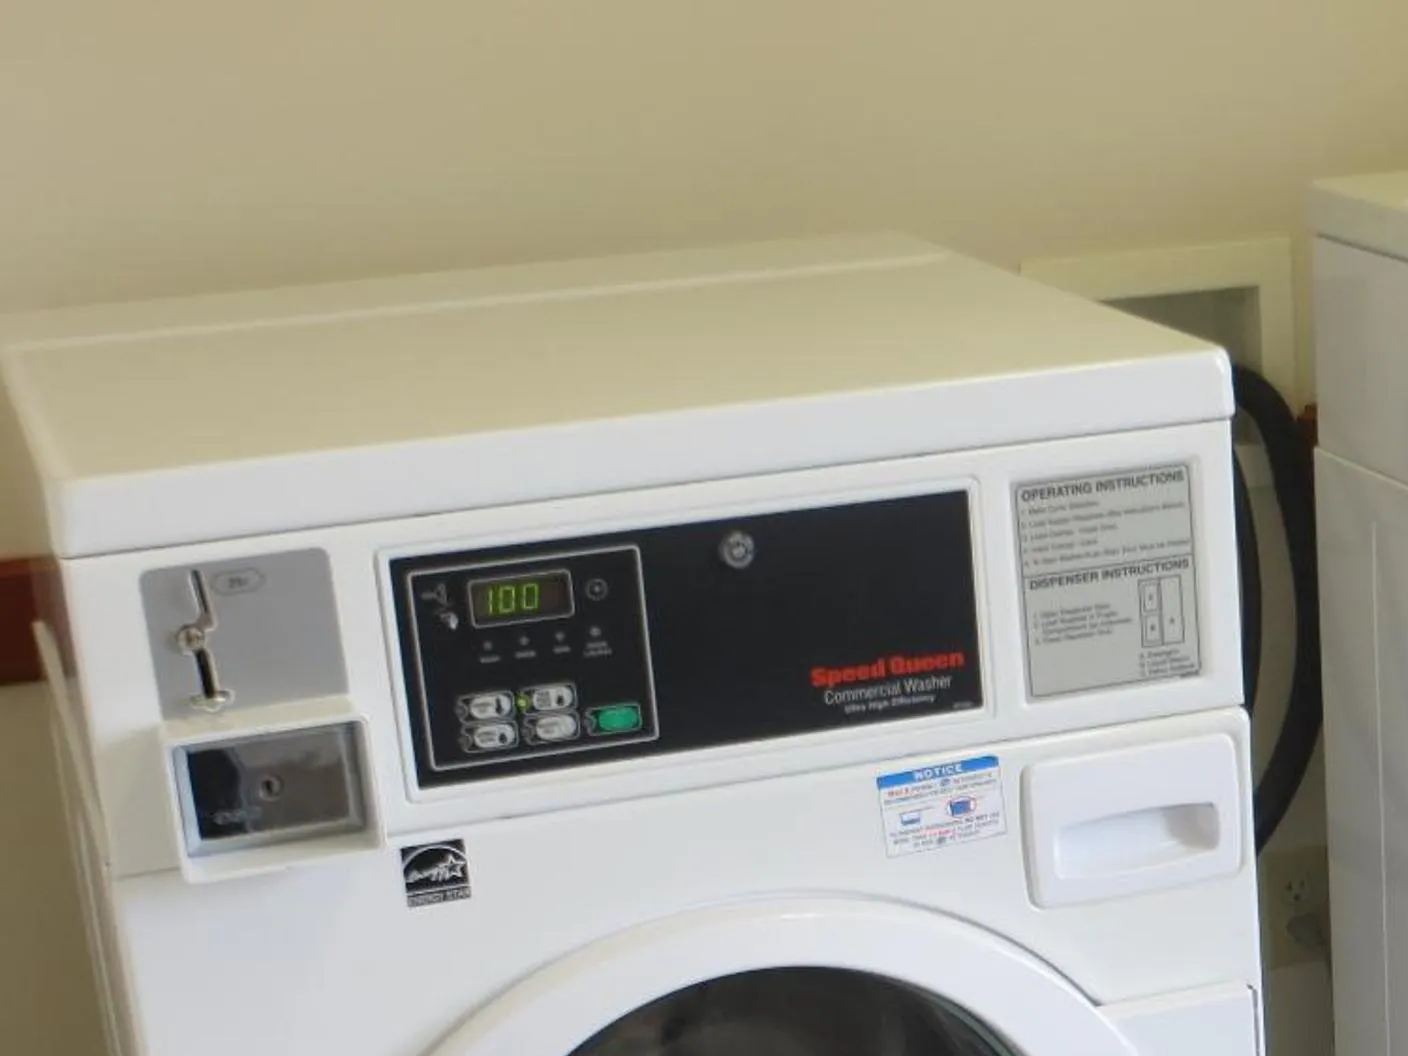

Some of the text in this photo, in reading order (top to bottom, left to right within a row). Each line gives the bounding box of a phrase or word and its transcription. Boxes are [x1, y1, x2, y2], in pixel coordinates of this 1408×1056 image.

[1021, 469, 1185, 501] OPERATING INSTRUCTIONS
[1029, 557, 1190, 591] DISPENSER INSTRUCTIONS
[487, 582, 540, 616] 100
[811, 652, 965, 687] Speed Queen
[825, 675, 952, 705] Commercial Washer
[914, 764, 963, 783] NOTICE
